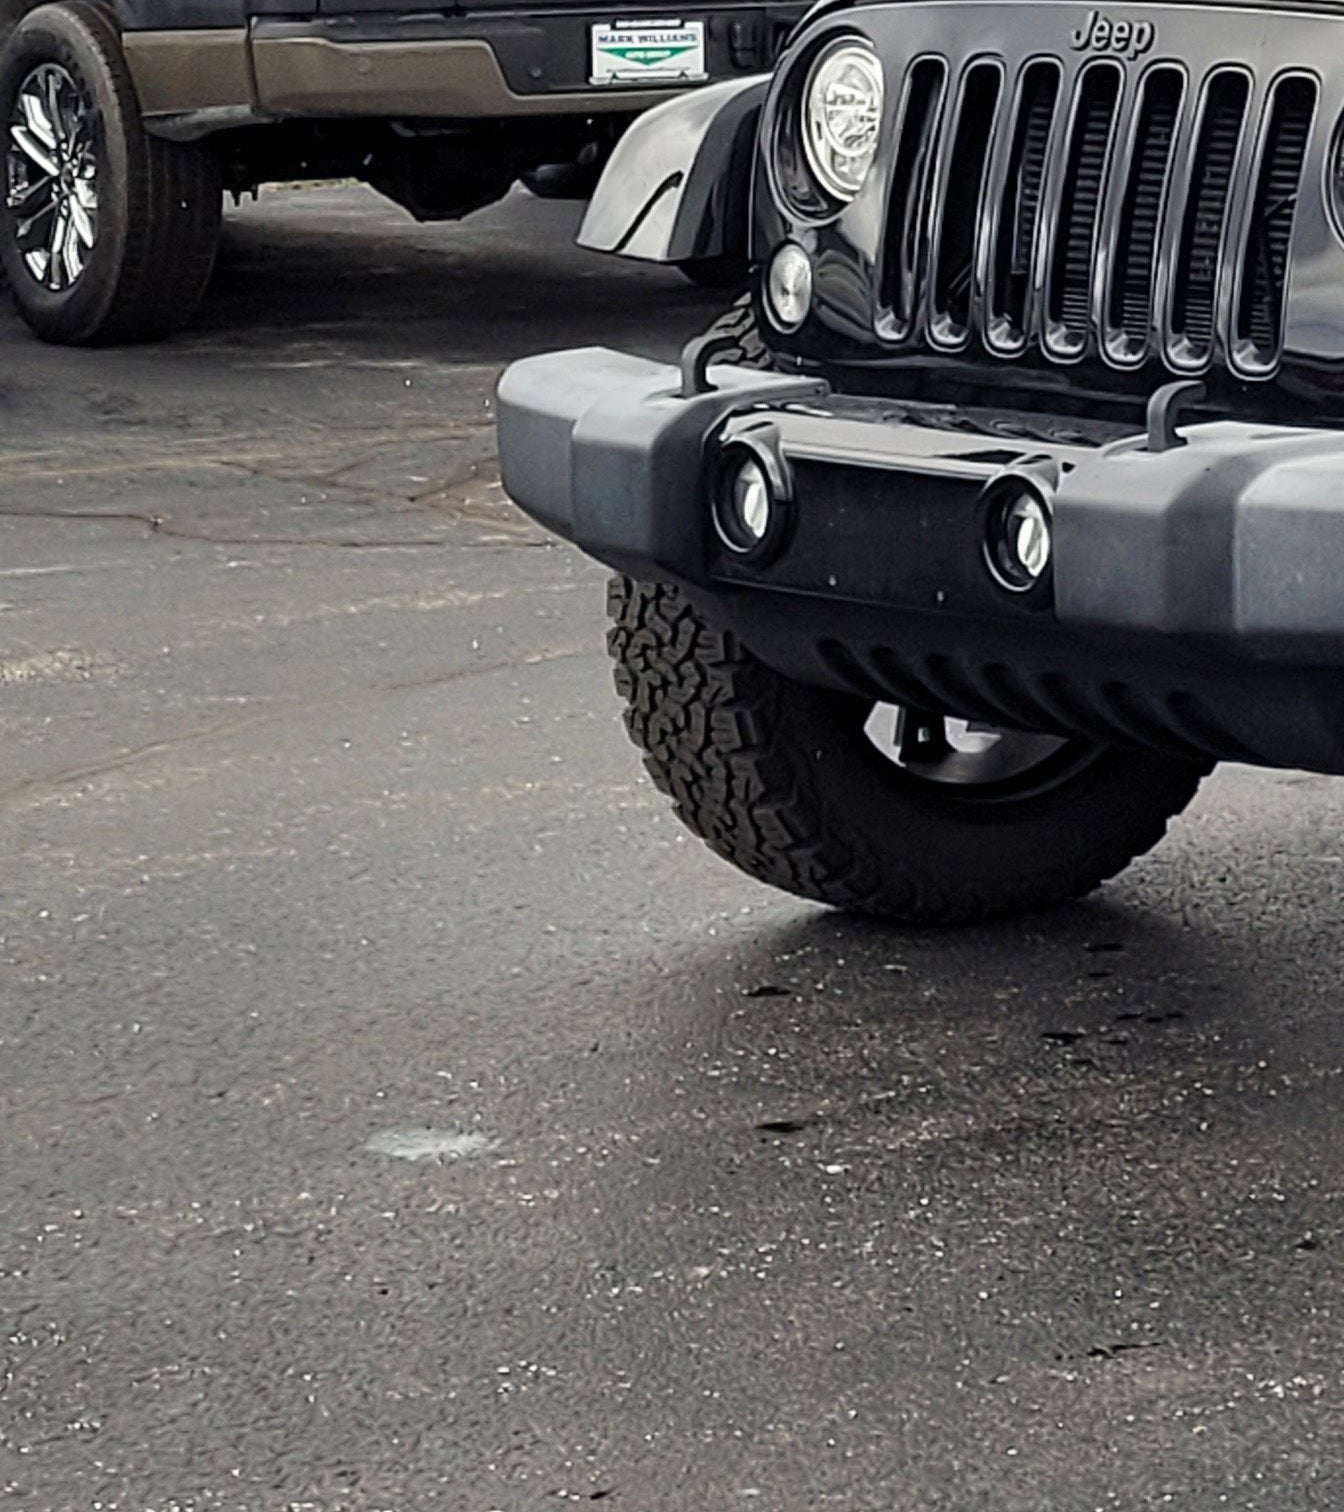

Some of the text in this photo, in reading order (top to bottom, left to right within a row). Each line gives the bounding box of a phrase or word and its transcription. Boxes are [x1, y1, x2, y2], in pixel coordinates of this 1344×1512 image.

[598, 33, 697, 43] MARK WILLIAMS
[1071, 9, 1155, 61] Jeep
